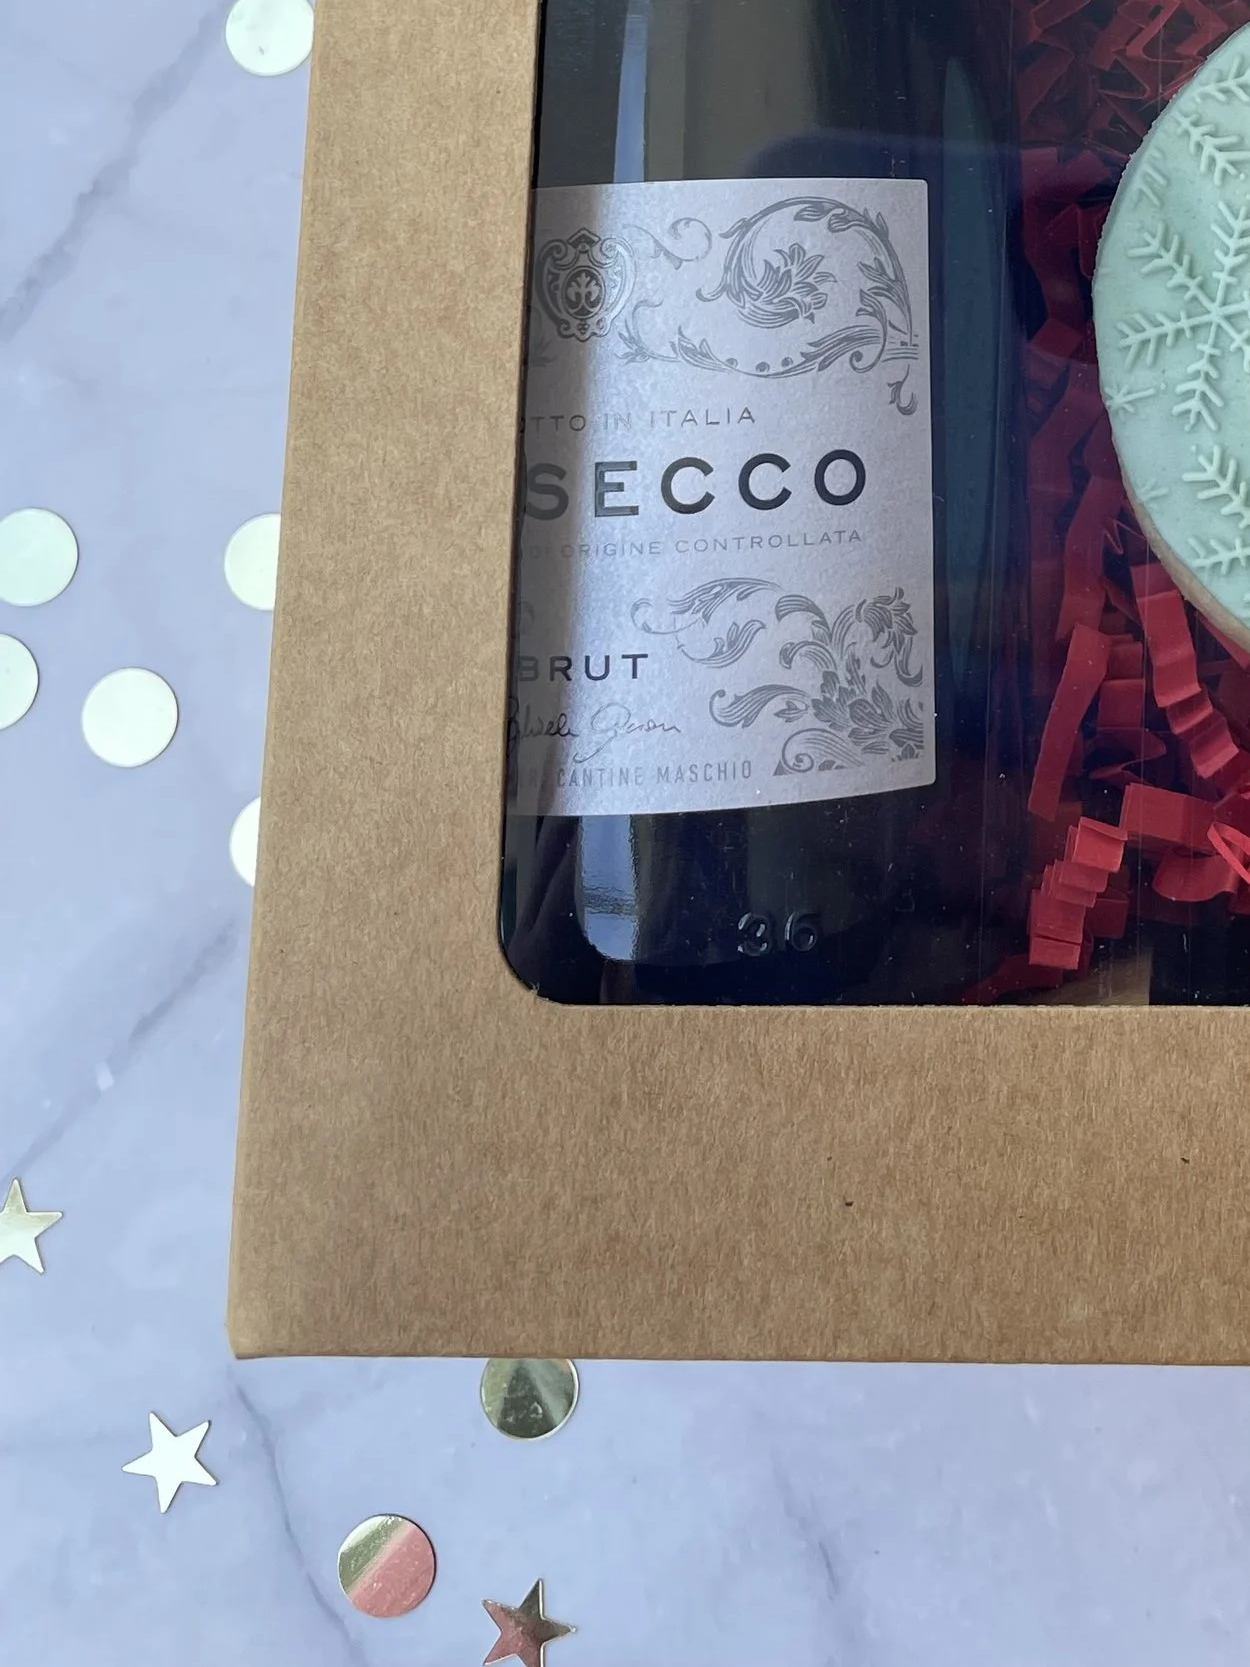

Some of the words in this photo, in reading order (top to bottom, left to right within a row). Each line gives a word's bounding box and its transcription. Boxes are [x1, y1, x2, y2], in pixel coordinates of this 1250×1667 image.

[602, 411, 633, 431] IN
[649, 405, 757, 430] ITALIA
[525, 448, 868, 522] SECCO
[674, 529, 864, 555] CONTROLLATA
[518, 652, 650, 683] BRUT
[556, 765, 645, 789] CANTINE
[655, 759, 753, 786] MASCHIO
